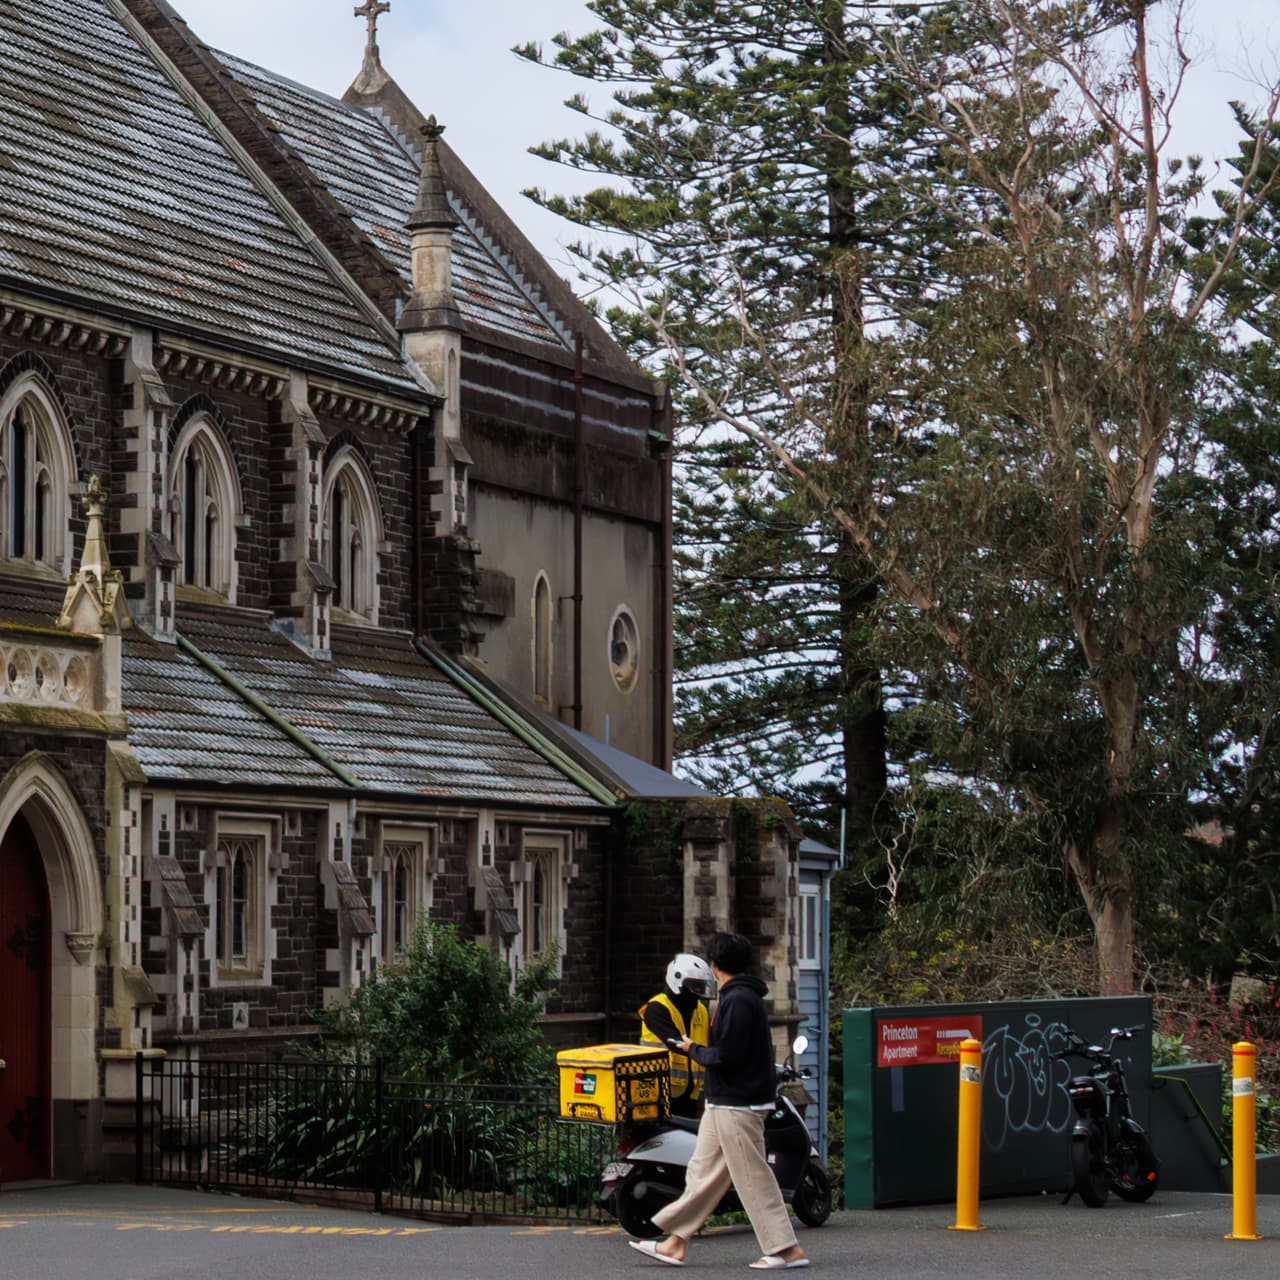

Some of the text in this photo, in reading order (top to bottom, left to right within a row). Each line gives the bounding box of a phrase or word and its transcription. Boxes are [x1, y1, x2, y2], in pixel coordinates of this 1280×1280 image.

[882, 1024, 918, 1040] Princeton
[883, 1045, 918, 1062] Apartment
[636, 1079, 656, 1090] JOIN
[639, 1089, 651, 1098] US
